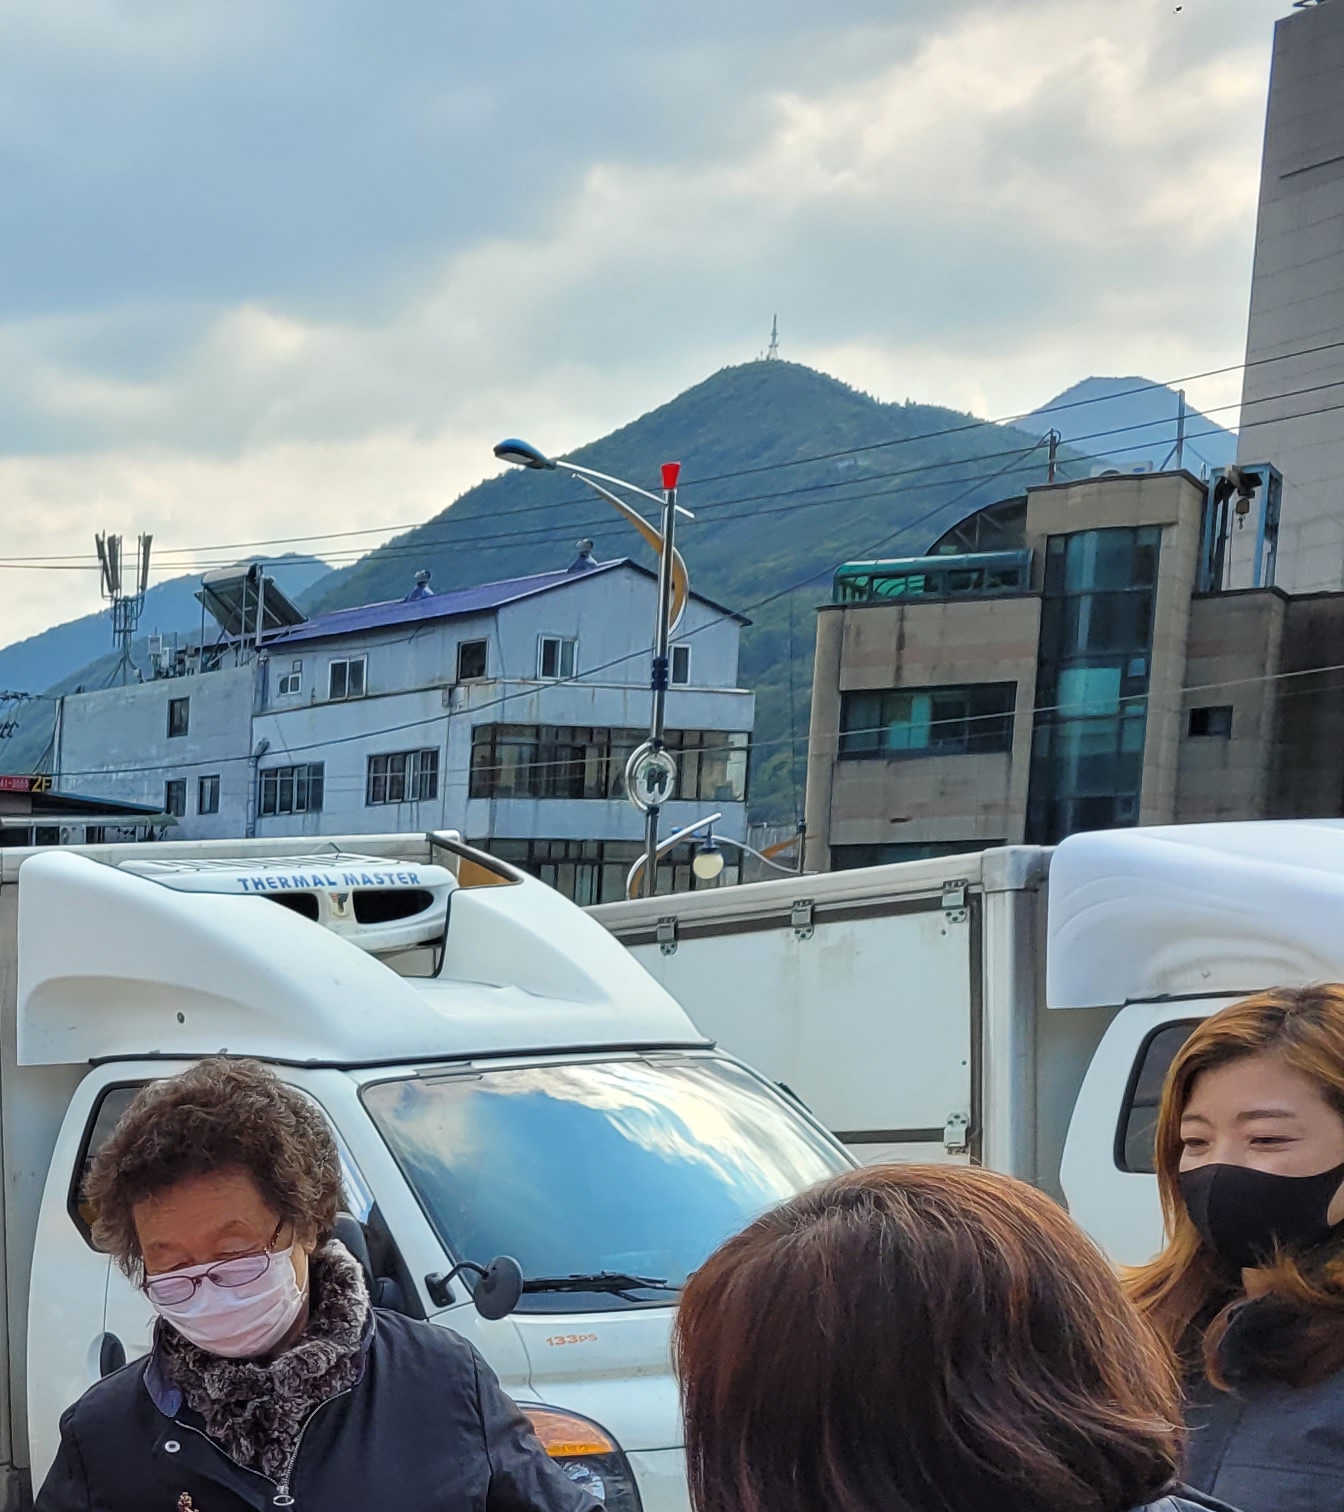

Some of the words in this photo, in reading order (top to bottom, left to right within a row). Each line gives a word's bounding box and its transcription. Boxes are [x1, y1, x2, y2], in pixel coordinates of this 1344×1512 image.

[31, 776, 53, 793] 2F
[237, 875, 337, 891] THERMAL
[342, 872, 421, 886] MASTER
